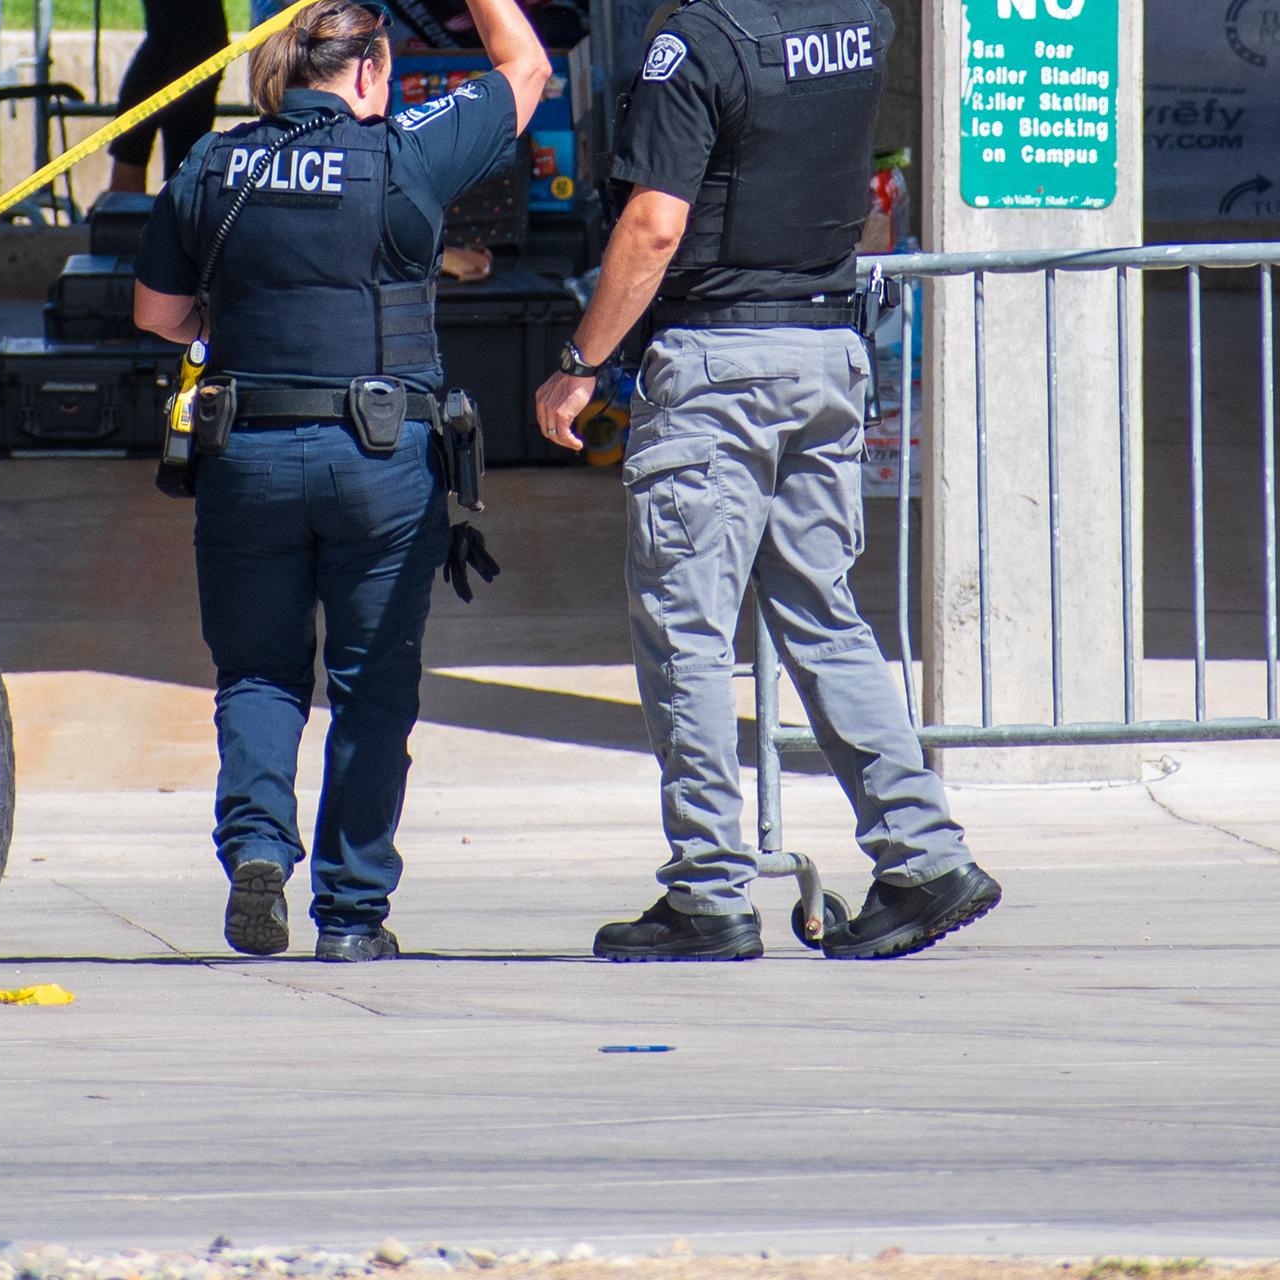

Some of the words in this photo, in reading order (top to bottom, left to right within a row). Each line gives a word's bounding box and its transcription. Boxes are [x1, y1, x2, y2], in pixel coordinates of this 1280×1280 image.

[786, 26, 873, 78] POLICE
[972, 66, 1027, 85] Roller
[1041, 66, 1109, 89] Blading
[1039, 92, 1109, 115] Skating
[971, 117, 1003, 137] Ice
[1019, 117, 1109, 142] Blocking
[982, 147, 1006, 162] on
[1021, 145, 1098, 168] Campus
[226, 148, 344, 192] POLICE
